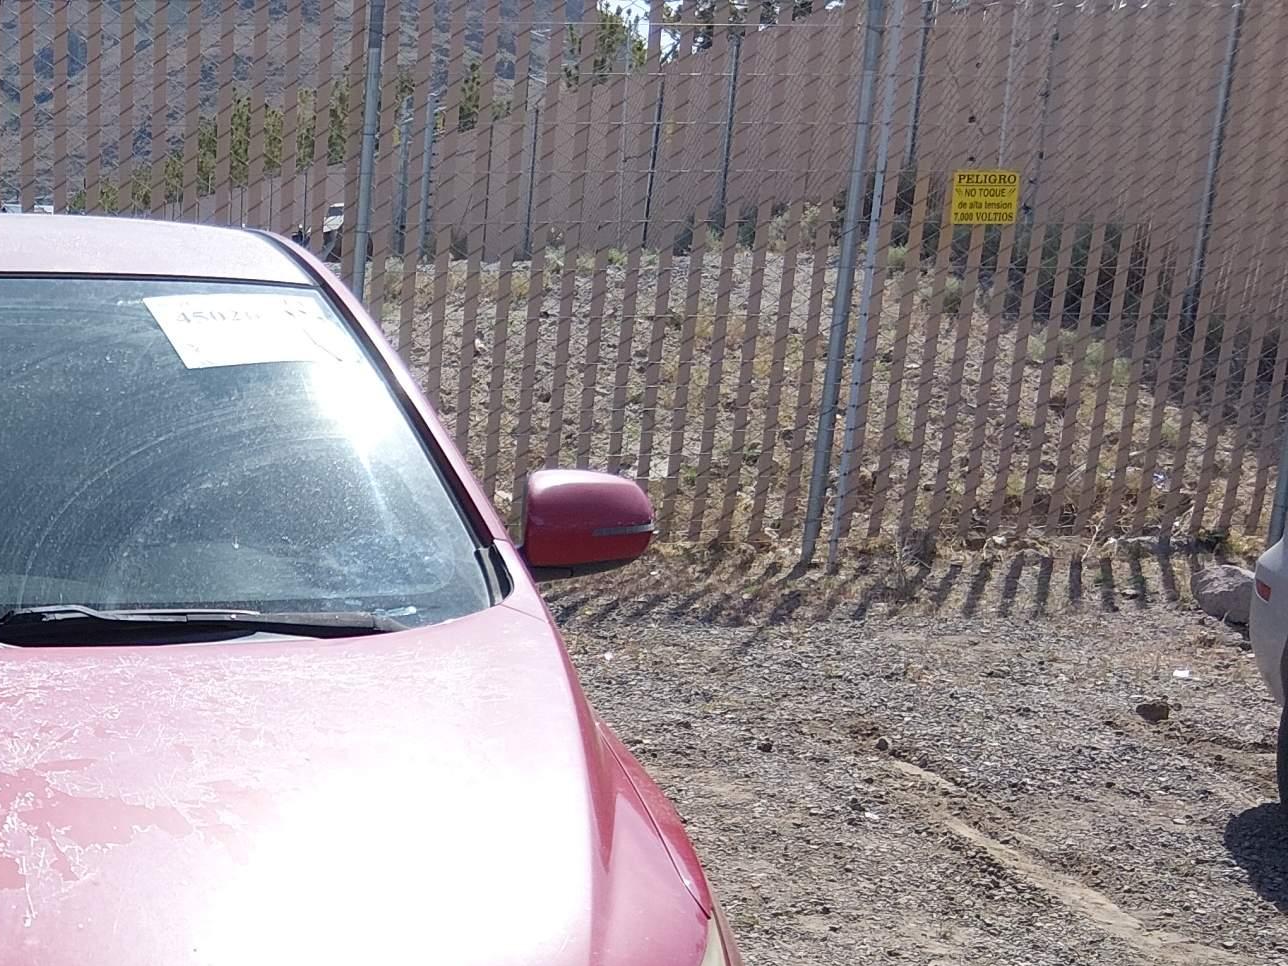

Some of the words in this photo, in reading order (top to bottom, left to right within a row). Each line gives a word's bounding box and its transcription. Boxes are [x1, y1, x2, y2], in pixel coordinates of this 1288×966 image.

[958, 174, 1017, 184] PELIGRO
[965, 188, 976, 197] NO
[979, 188, 1005, 197] TOQUE
[957, 201, 967, 210] de
[969, 201, 982, 210] alta
[976, 212, 1014, 222] VOLTIOS
